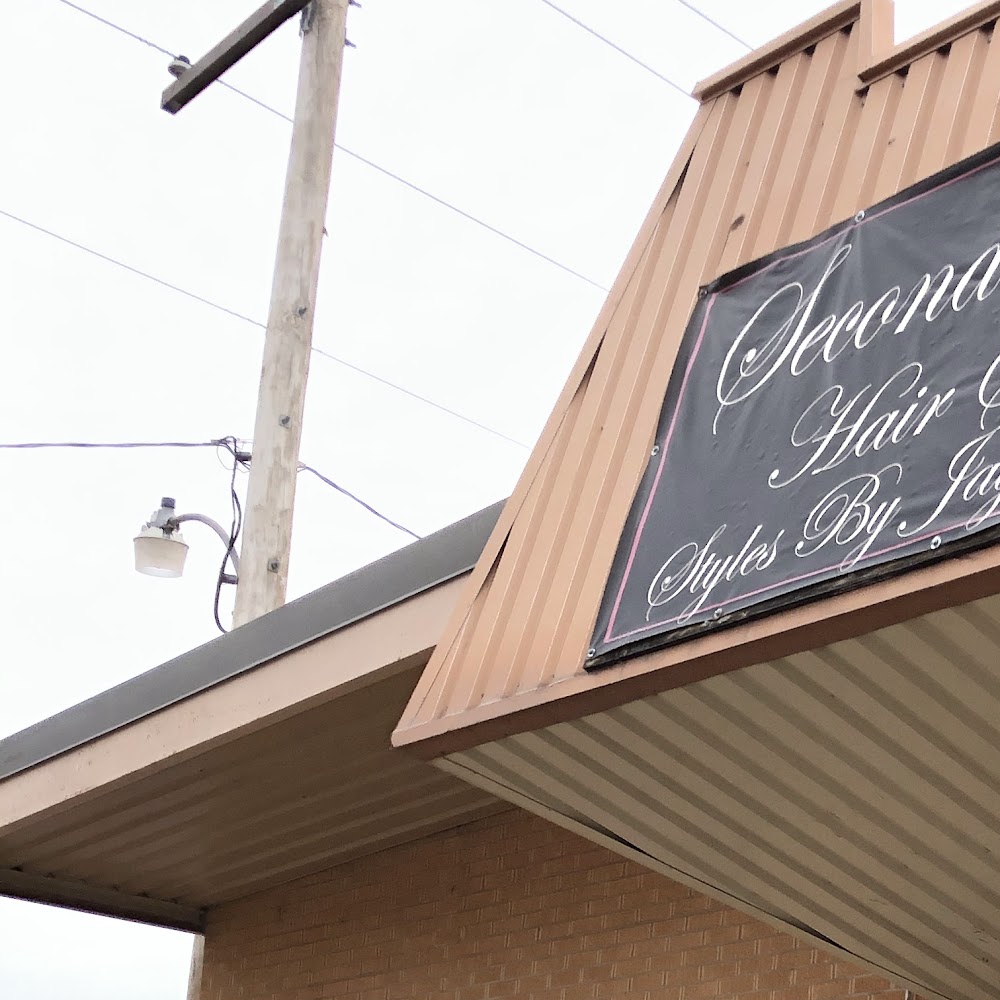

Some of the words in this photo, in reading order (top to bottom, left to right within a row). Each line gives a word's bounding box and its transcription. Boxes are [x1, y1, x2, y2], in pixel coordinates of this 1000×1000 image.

[768, 361, 957, 489] Hair
[646, 525, 780, 624] Styles
[795, 463, 904, 573] By
